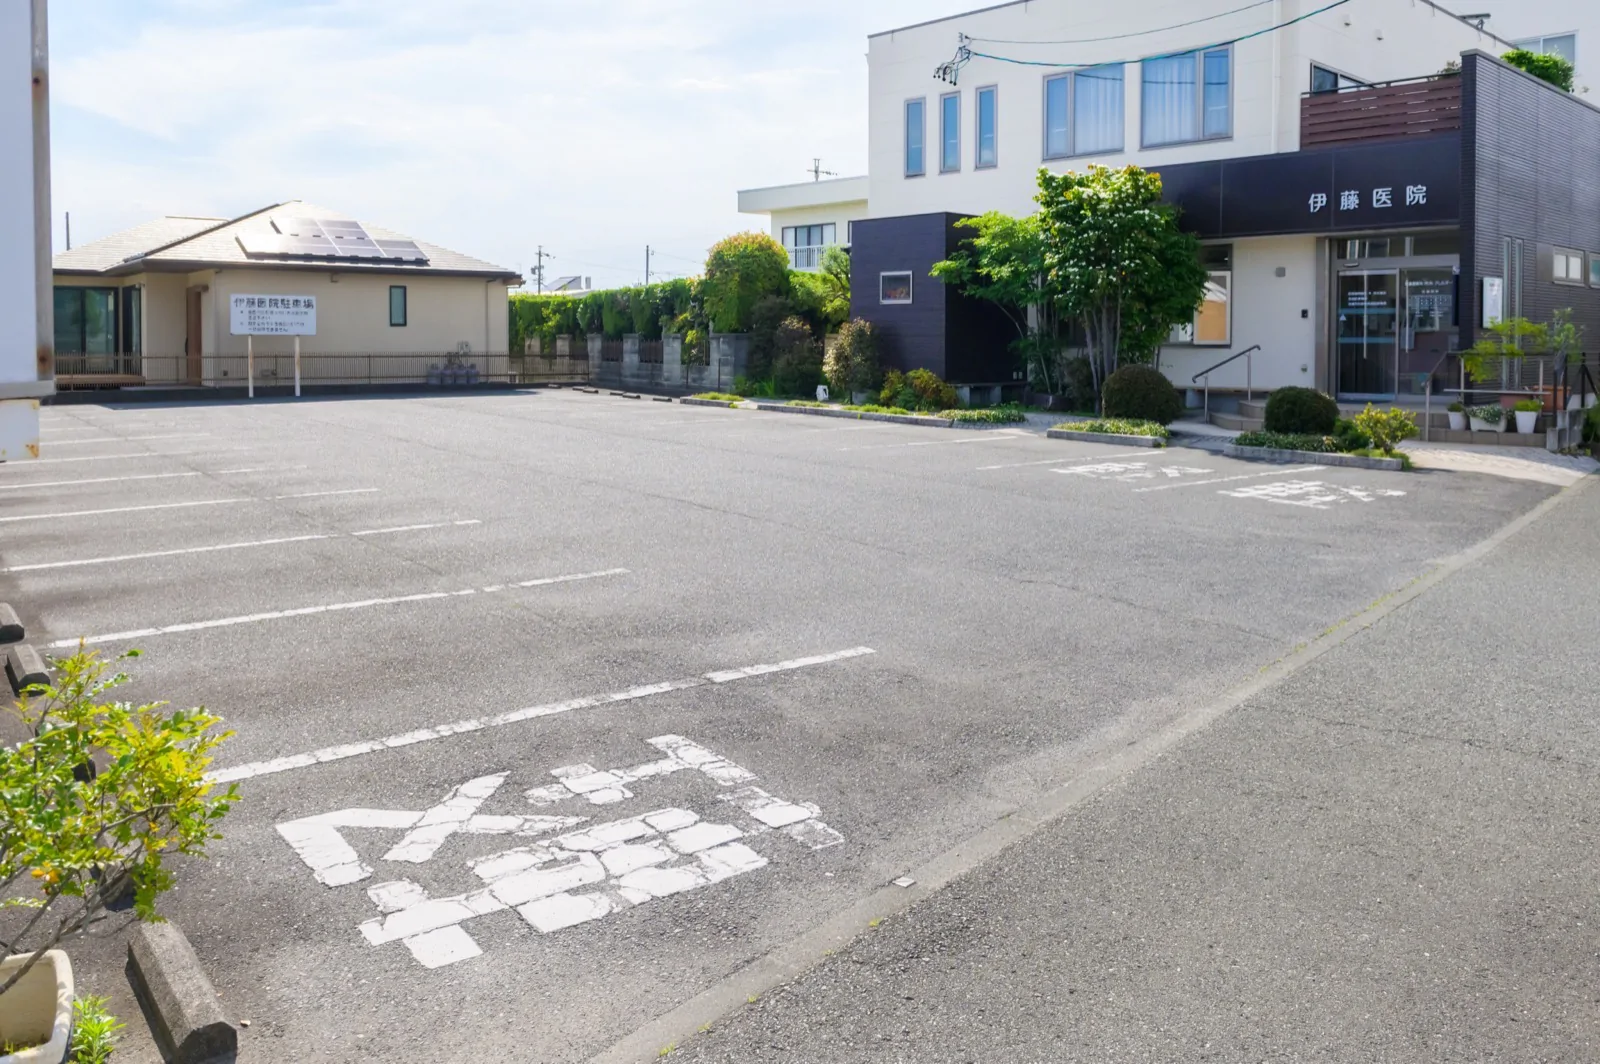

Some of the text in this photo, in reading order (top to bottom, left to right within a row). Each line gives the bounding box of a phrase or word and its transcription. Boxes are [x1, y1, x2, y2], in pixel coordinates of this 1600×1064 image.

[1308, 184, 1427, 213] 伊藤医院
[234, 297, 314, 309] 伊藤医院駐車場
[275, 734, 844, 969] 軽
